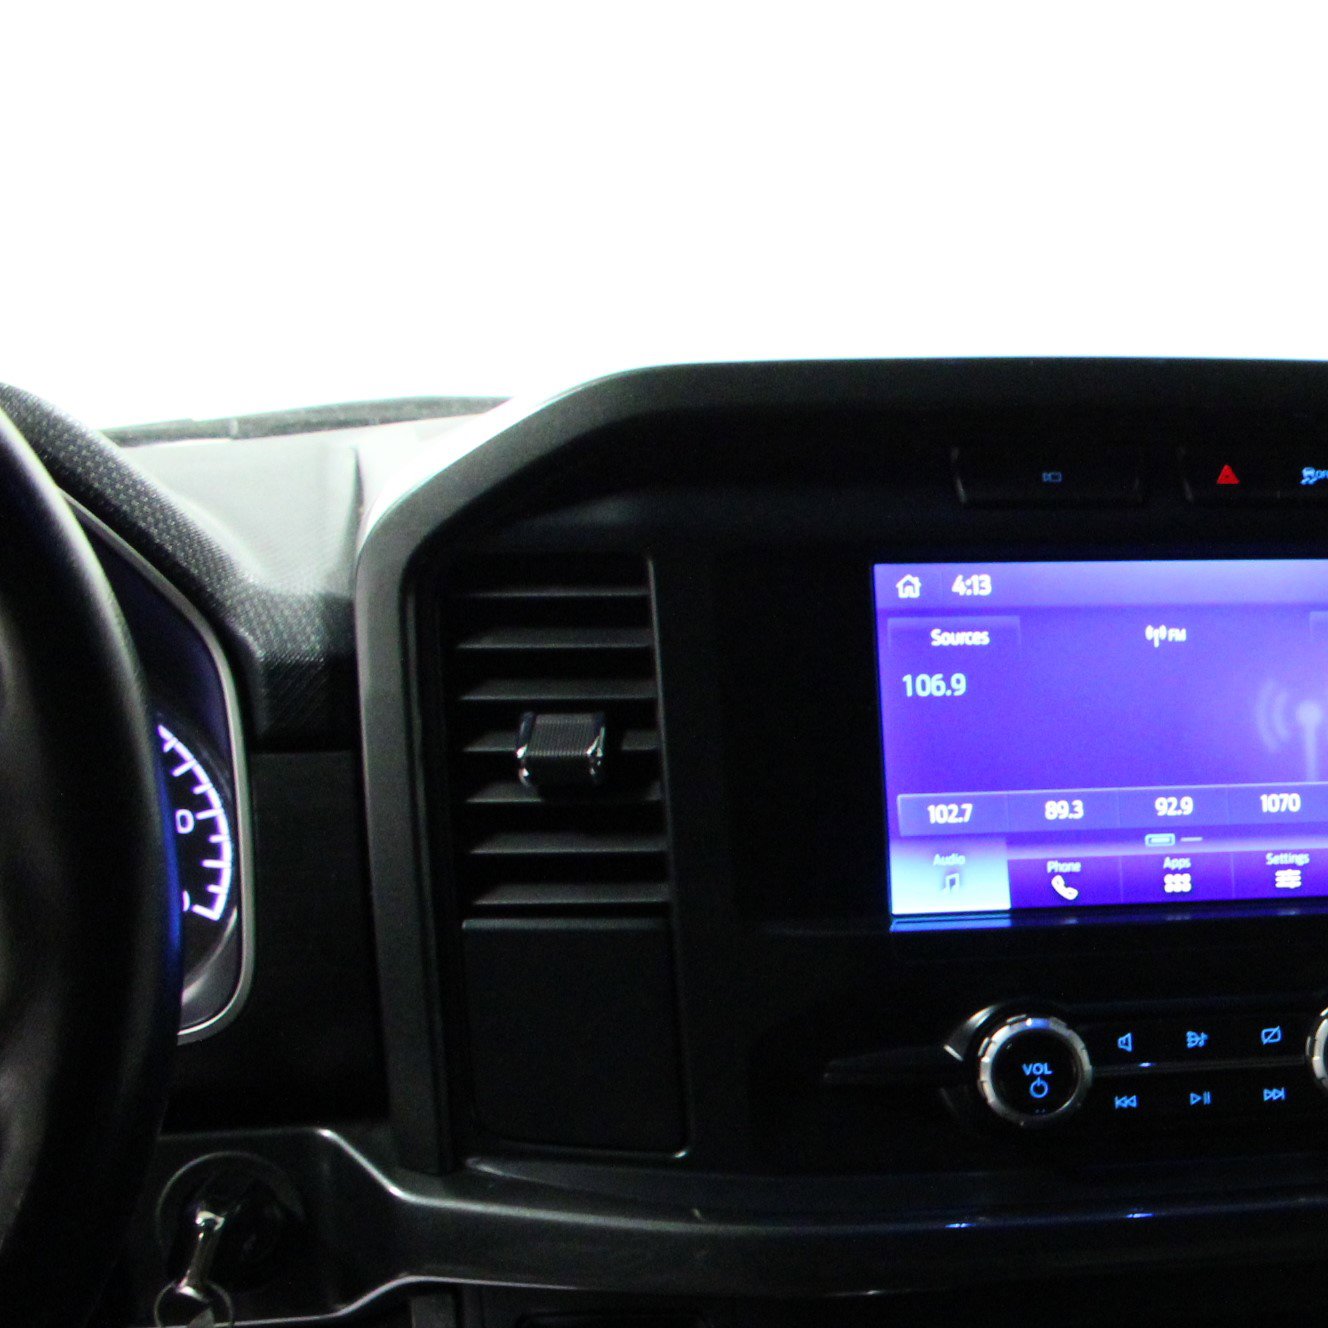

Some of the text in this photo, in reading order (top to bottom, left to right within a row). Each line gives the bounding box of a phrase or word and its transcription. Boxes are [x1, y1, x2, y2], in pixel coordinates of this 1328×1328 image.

[951, 574, 992, 596] 4:13
[930, 628, 990, 646] Sources
[1168, 628, 1187, 642] FM
[902, 673, 967, 697] 106.9
[1044, 800, 1085, 820] 89.3
[1154, 796, 1194, 818] 92.9
[1260, 793, 1301, 813] 1070
[927, 803, 973, 825] 102.7
[932, 852, 966, 868] Audio
[1046, 859, 1082, 875] Phone
[1163, 856, 1191, 873] Apps
[1265, 850, 1311, 868] Settings
[1022, 1062, 1053, 1077] VOL
